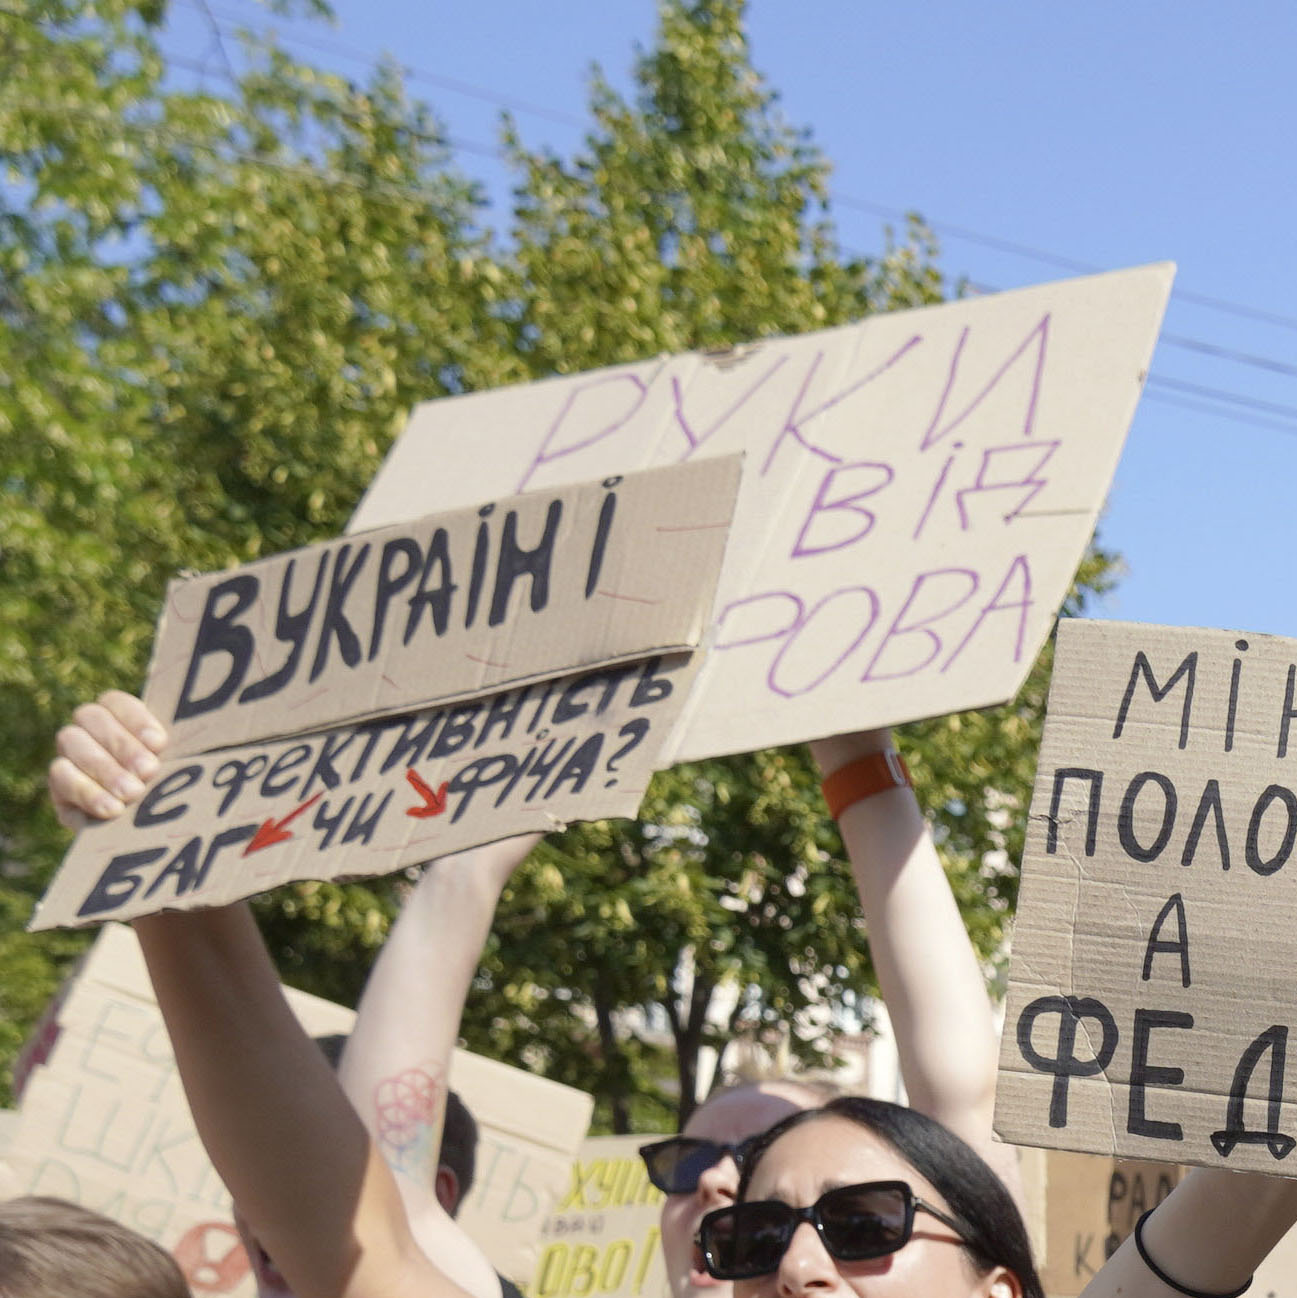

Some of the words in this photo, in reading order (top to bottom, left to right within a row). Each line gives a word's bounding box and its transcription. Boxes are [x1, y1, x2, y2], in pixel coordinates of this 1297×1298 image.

[517, 312, 1052, 493] РУКИ
[790, 440, 1062, 559] ВІД
[76, 824, 258, 917] БАГ
[312, 789, 394, 852] ЧИ
[1142, 892, 1193, 989] А
